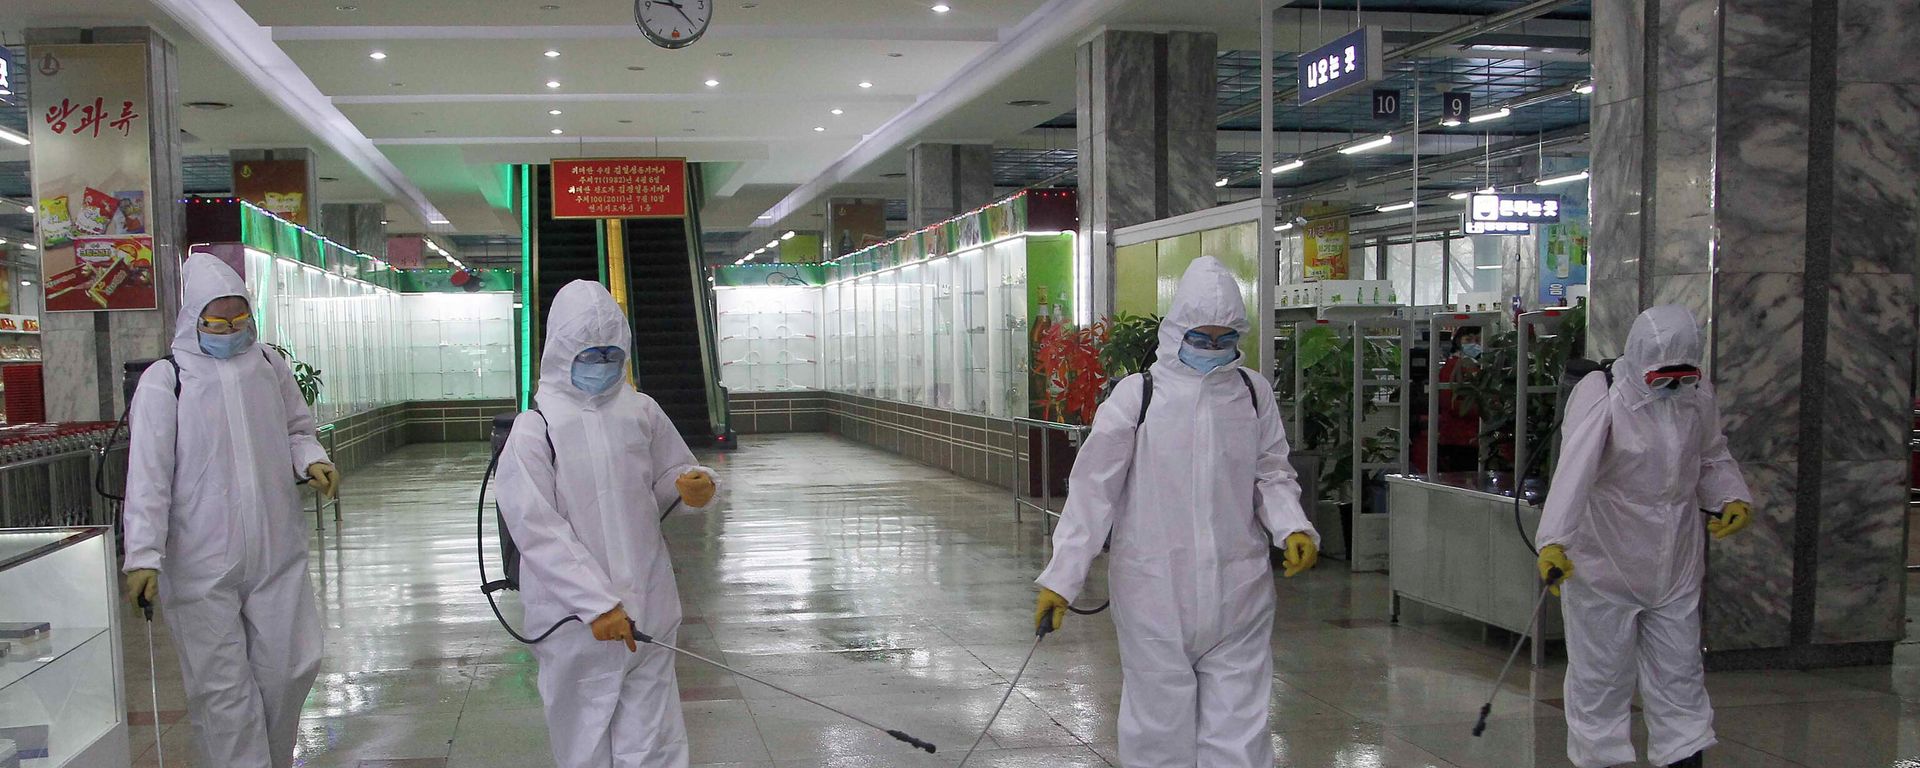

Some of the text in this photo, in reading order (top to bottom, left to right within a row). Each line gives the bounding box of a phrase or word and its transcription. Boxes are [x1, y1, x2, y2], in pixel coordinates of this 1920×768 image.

[1307, 45, 1355, 89] 나오는 곳
[1377, 95, 1396, 114] 10
[1451, 98, 1462, 116] 9
